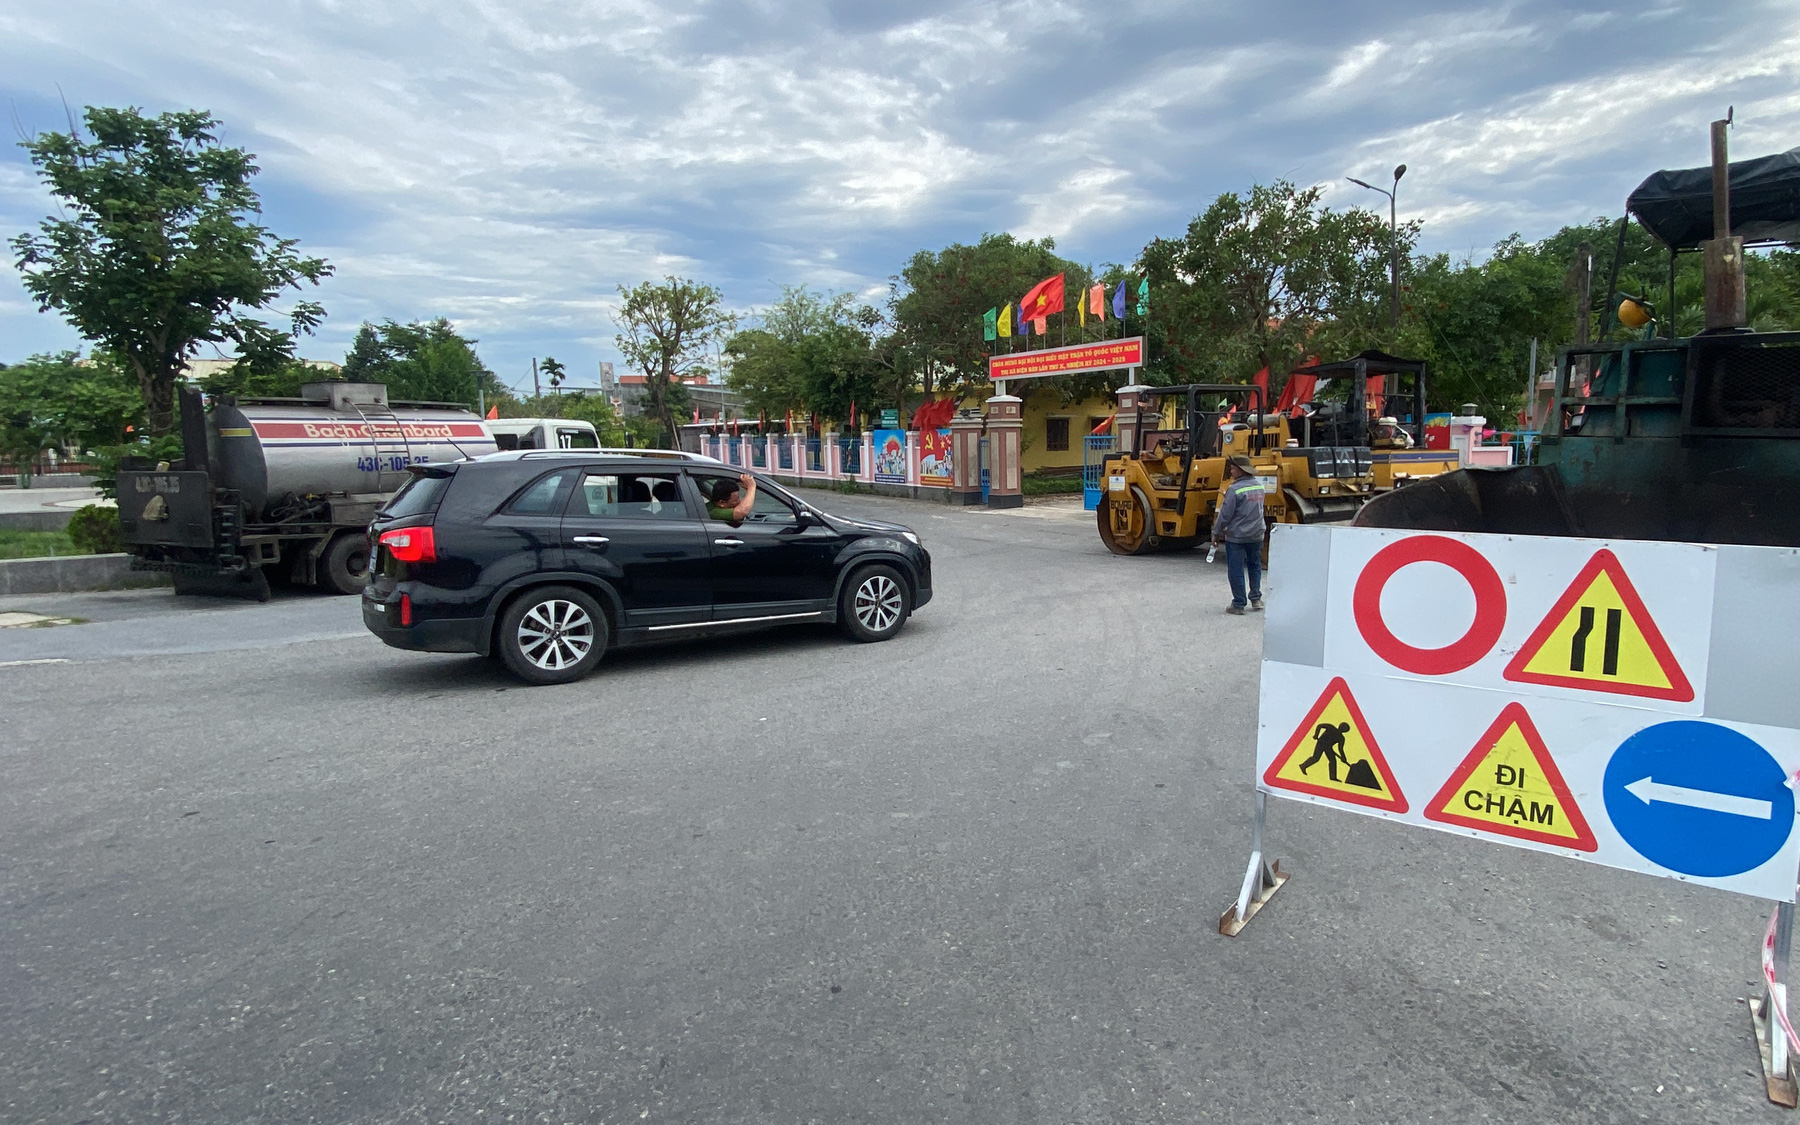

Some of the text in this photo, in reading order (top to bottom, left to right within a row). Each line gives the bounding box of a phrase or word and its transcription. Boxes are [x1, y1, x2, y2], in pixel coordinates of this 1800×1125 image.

[1094, 348, 1108, 357] QUỐC
[1110, 346, 1123, 354] VIỆT
[1111, 500, 1132, 510] BOMAG
[1495, 764, 1525, 788] ĐI
[1464, 790, 1554, 826] CHẬM
